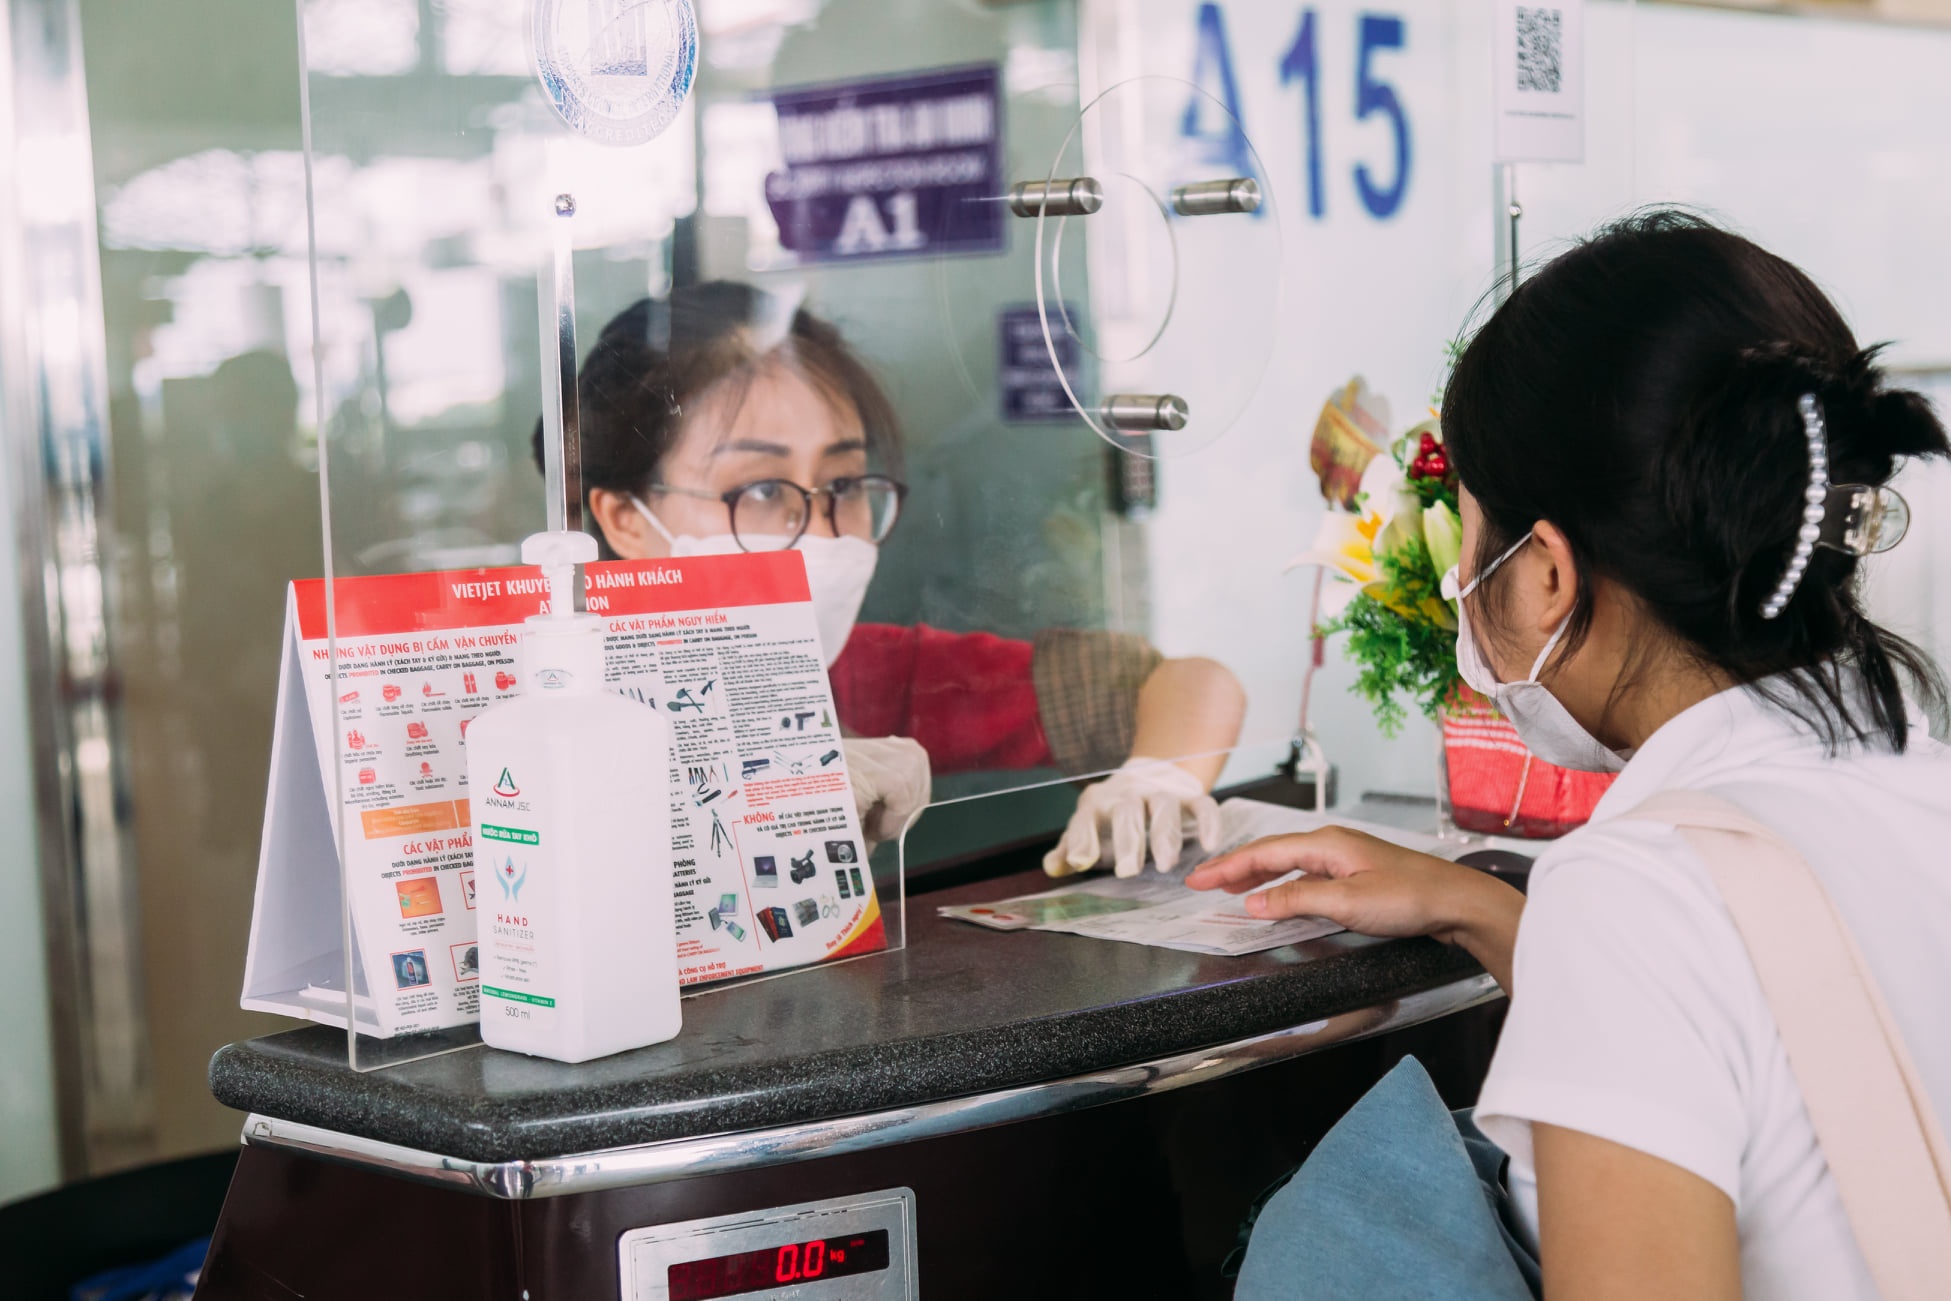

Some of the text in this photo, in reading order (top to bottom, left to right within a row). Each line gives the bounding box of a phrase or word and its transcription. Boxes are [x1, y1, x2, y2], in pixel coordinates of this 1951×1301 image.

[836, 192, 923, 254] A1
[451, 581, 501, 601] VIETJET
[596, 570, 635, 589] HÀNH
[637, 566, 683, 586] KHÁCH
[609, 619, 627, 633] CÁC
[678, 616, 702, 627] NGUY
[312, 647, 356, 660] NHNG
[380, 641, 410, 657] DỤNG
[413, 640, 425, 655] BỊ
[454, 635, 477, 651] VẬN
[479, 628, 518, 647] CHUYỂN
[486, 797, 531, 812] ANNAM JSC
[743, 811, 775, 825] KHÔNG
[403, 842, 424, 855] CÁC
[425, 839, 445, 855] VẬT
[673, 859, 696, 869] PHÒNG
[673, 869, 697, 877] ATTERIES
[497, 914, 529, 927] HAND
[492, 925, 535, 940] SANITIZER
[684, 966, 698, 975] CÔNG
[686, 976, 698, 984] LAW
[505, 1006, 531, 1021] 500 ml
[776, 1240, 845, 1282] 0.0 kg
